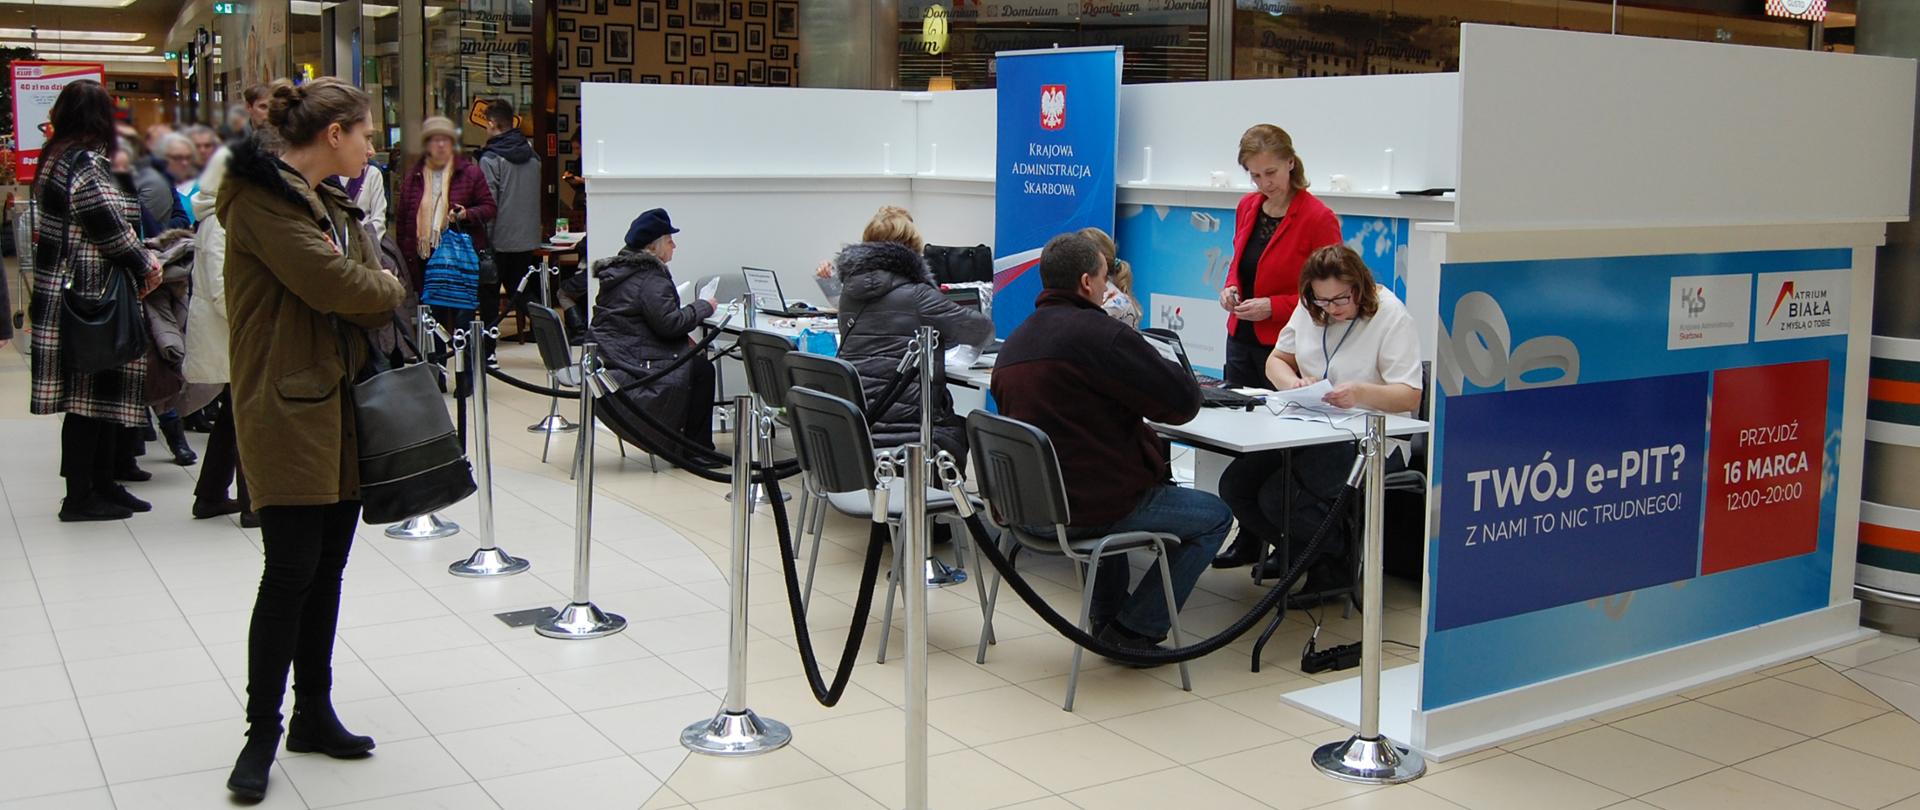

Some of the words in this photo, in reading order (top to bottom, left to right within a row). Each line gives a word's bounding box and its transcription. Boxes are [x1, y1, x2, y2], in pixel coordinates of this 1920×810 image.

[1001, 5, 1058, 17] Dominium
[1082, 2, 1140, 15] Dominium
[1163, 0, 1208, 12] Domini
[460, 40, 530, 53] ominium
[1261, 30, 1336, 52] Dominium
[1029, 142, 1074, 158] KRAJOWA
[1012, 161, 1092, 179] ADMINISTRACJA
[1024, 180, 1076, 196] SKARBOWA
[1794, 290, 1827, 300] ATRIUM
[1789, 300, 1831, 318] BIAŁA
[1807, 319, 1813, 329] O
[1739, 419, 1799, 448] PRZYJDŹ
[1724, 460, 1741, 485] 16
[1747, 450, 1808, 481] MARCA
[1467, 450, 1575, 512] TWÓJ
[1586, 444, 1685, 494] e-PIT?
[1727, 482, 1802, 511] 12:00-20:00
[1465, 525, 1477, 546] Z
[1482, 517, 1527, 543] NAMI
[1533, 512, 1555, 534] TO
[1560, 508, 1588, 530] NIC
[1593, 492, 1682, 524] TRUDNEGO!
